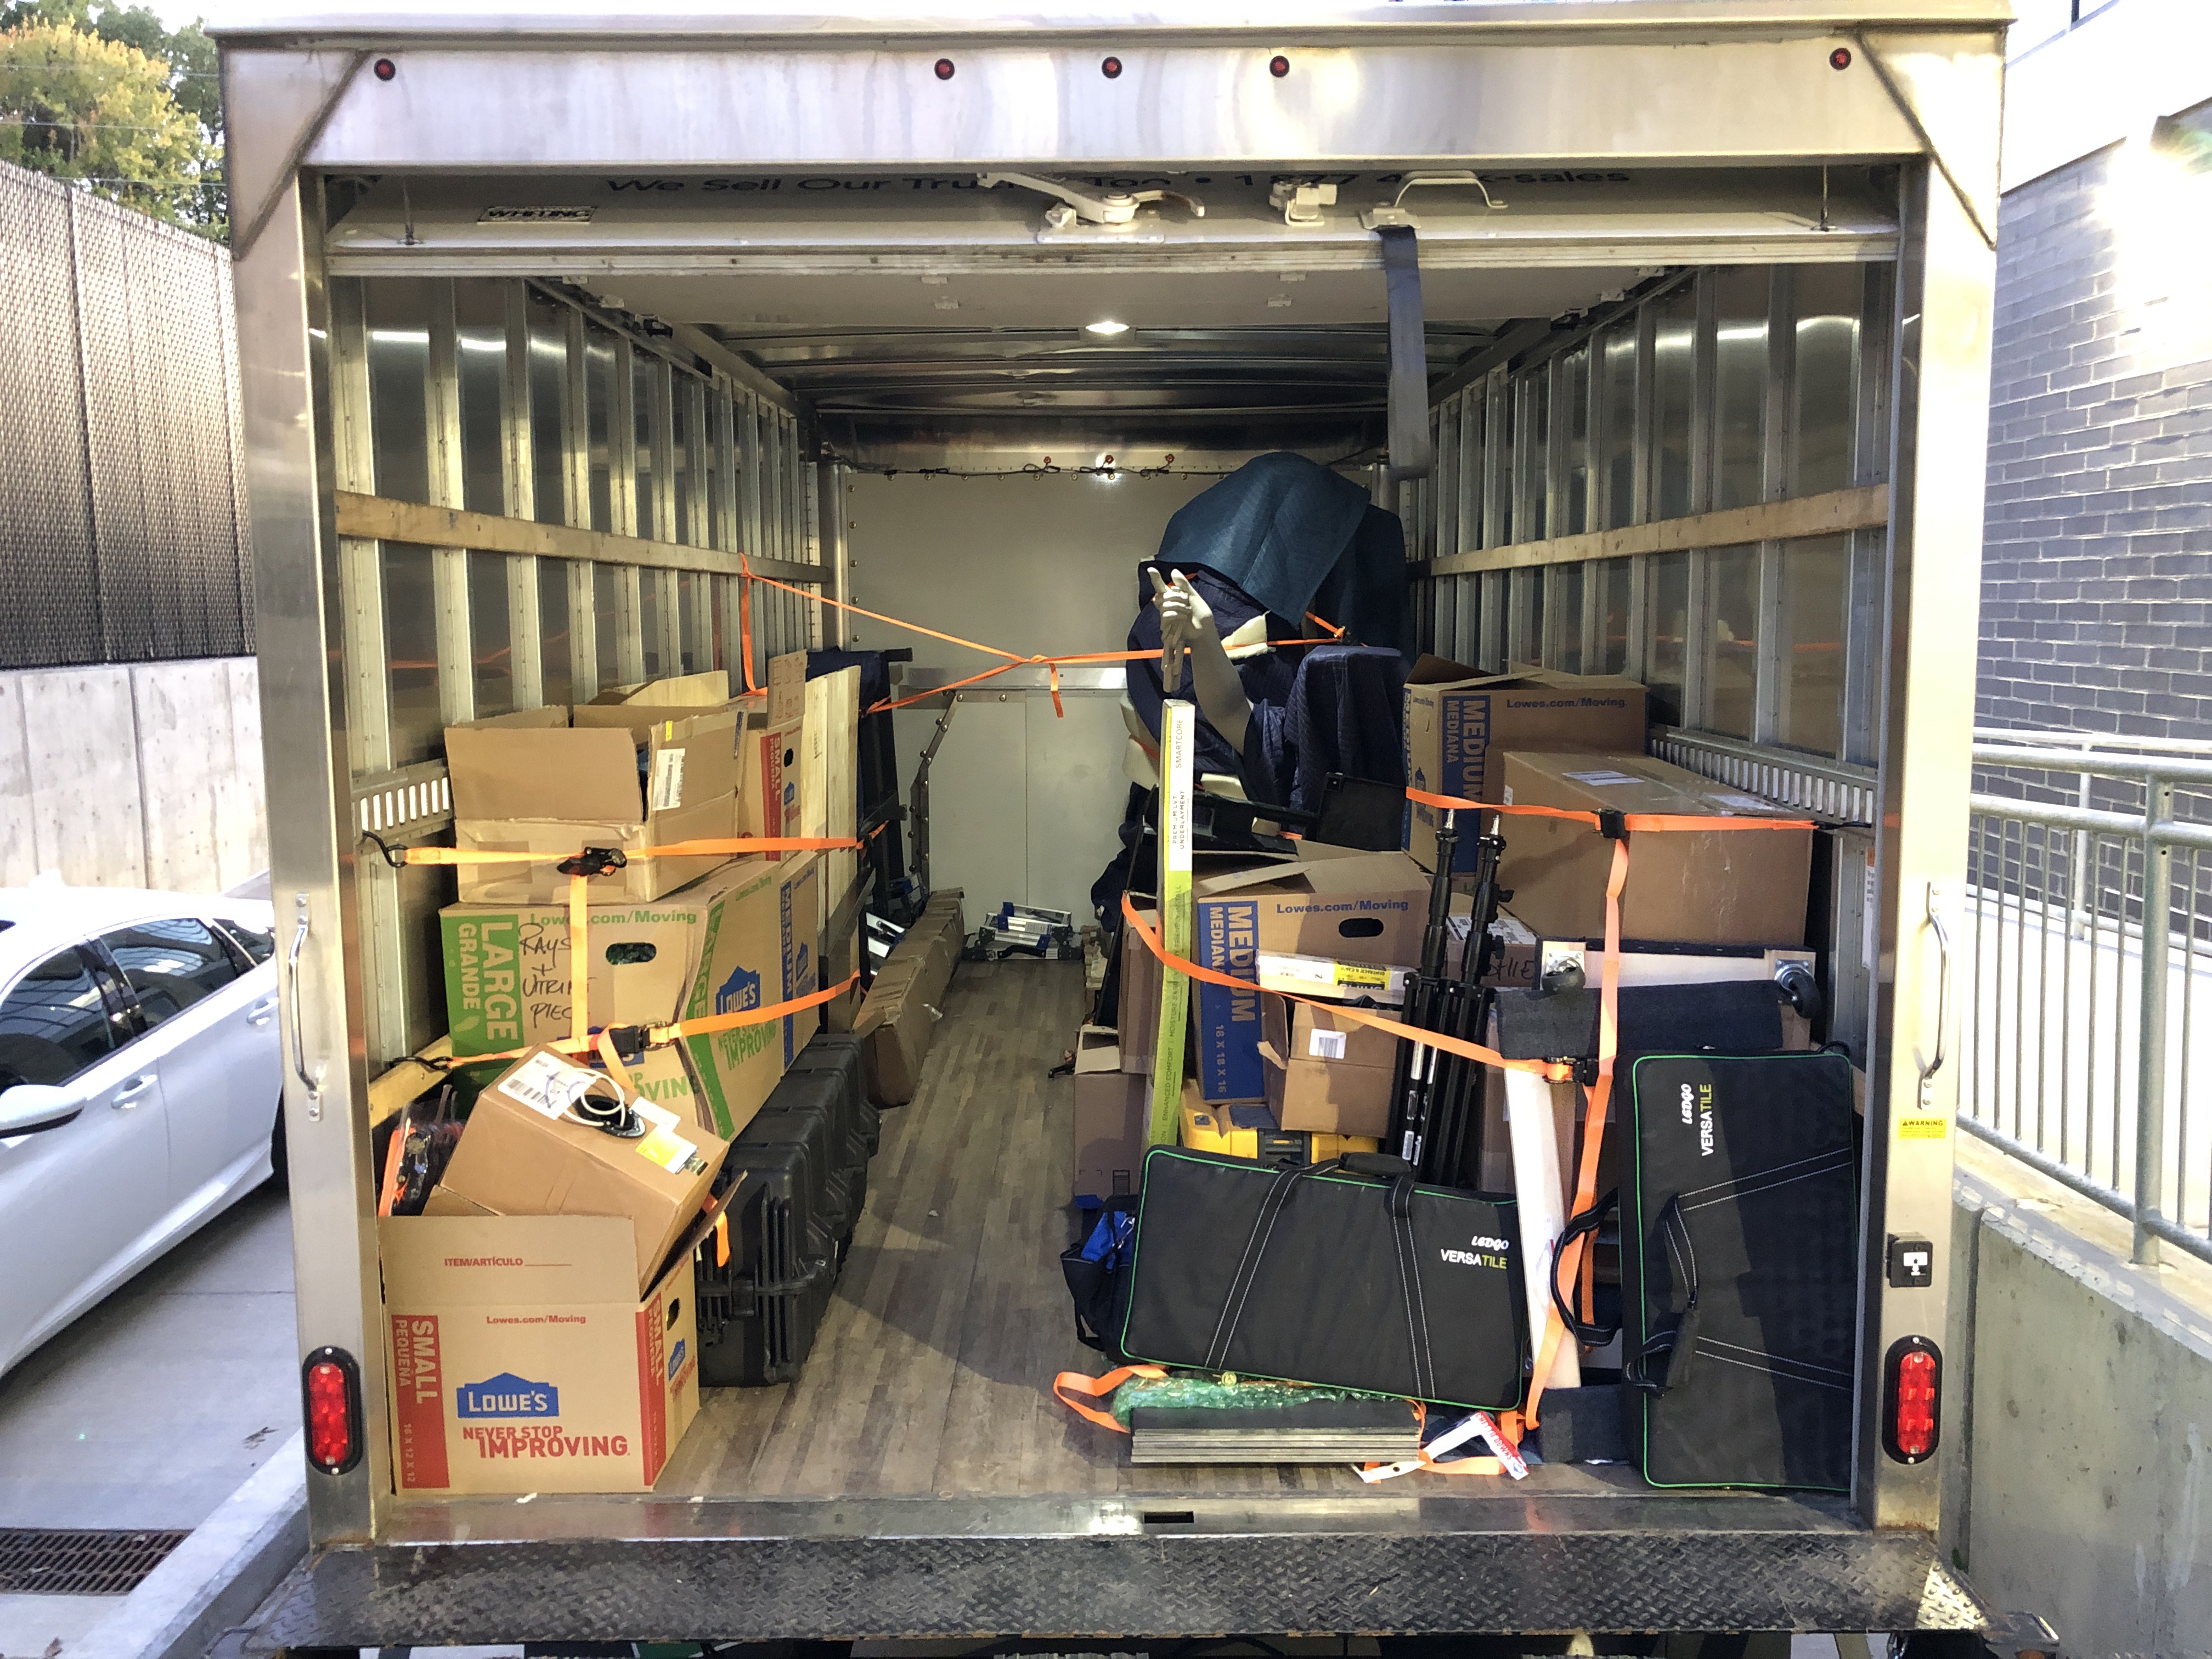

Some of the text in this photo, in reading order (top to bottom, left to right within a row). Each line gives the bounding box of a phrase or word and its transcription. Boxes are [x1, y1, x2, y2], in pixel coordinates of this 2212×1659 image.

[607, 178, 685, 192] We
[701, 177, 781, 191] Sell
[797, 177, 891, 191] Our
[1506, 697, 1627, 708] Lowes.com/Moving
[1447, 700, 1460, 764] MEDIANA
[774, 736, 782, 801] SMALL
[530, 909, 697, 926] Low.com/Moving
[1276, 899, 1409, 915] Lowes.com/Moving
[458, 923, 482, 1011] GRANDE
[481, 922, 520, 1042] LARGE
[720, 981, 757, 1015] LOWE'S
[1169, 1002, 1178, 1037] MOISTURE
[1165, 1047, 1173, 1081] COMFORT
[1162, 1082, 1171, 1121] ENHANCED
[1700, 1084, 1714, 1156] VERSATILE
[1441, 1249, 1508, 1269] VERSATILE
[487, 1314, 586, 1324] Lowes.com/Moving
[412, 1319, 438, 1404] SMALL
[468, 1390, 548, 1413] LOWE'S
[462, 1425, 563, 1440] NEVER STOP
[479, 1435, 629, 1459] IMPROVING
